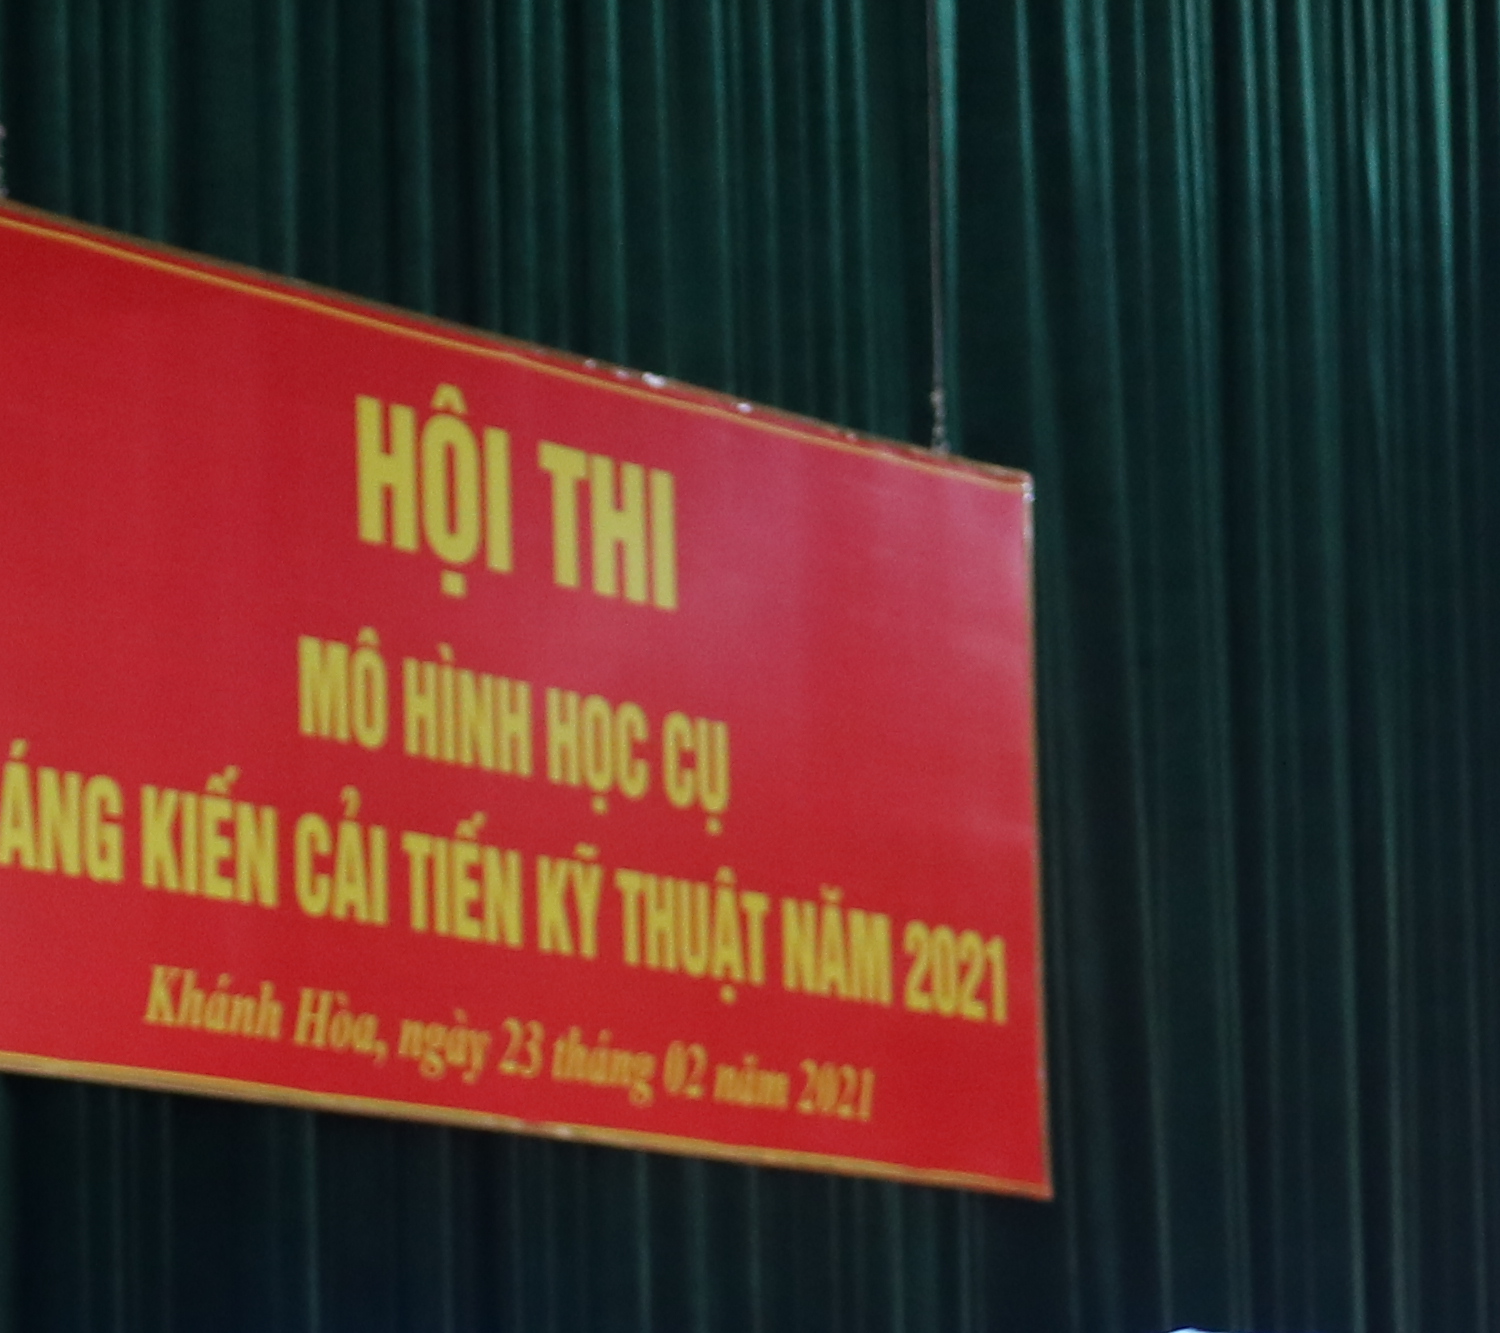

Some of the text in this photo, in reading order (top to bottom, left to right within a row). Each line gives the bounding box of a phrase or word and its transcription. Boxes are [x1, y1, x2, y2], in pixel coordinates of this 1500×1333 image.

[355, 384, 678, 611] HỘI THI
[299, 627, 731, 834] MÔ HÌNH HỌC CỤ
[140, 765, 280, 907] KIẾN
[295, 786, 389, 926] CẢI
[402, 811, 524, 947] TIẾN
[537, 843, 604, 960] KỸ
[615, 866, 770, 1004] THUẬT
[782, 885, 893, 1006] NĂM
[904, 921, 1008, 1023] 2021
[144, 965, 281, 1040] Khánh
[399, 1008, 490, 1083] ngày
[499, 1017, 544, 1075] 23
[553, 1026, 655, 1106] tháng
[664, 1041, 707, 1099] 02
[714, 1054, 789, 1112] năm
[798, 1059, 874, 1121] 2021
